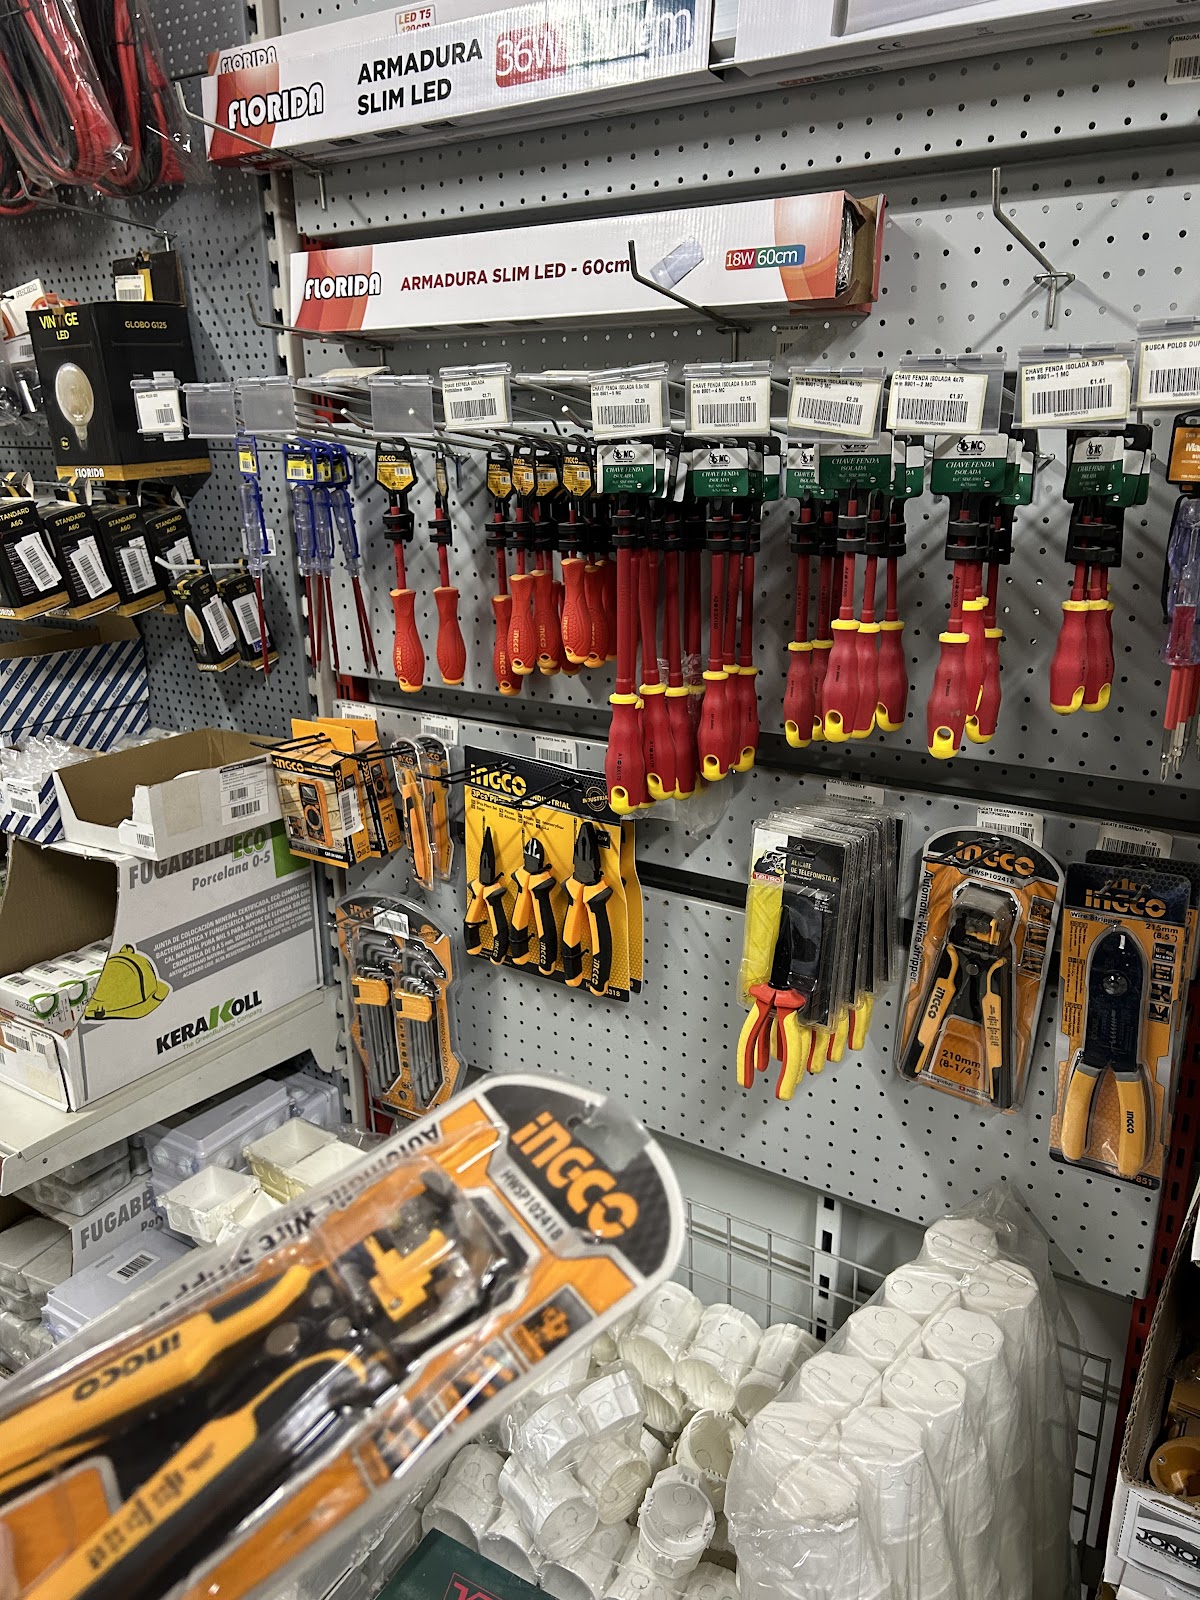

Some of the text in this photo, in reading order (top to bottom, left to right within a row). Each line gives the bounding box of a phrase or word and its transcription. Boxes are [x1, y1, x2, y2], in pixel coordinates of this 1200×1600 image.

[399, 8, 432, 25] LED T5
[357, 38, 482, 85] ARMADURA
[227, 82, 324, 130] FLORIDA
[357, 78, 452, 115] SLIM LED
[726, 248, 798, 267] 18W 60cm
[305, 271, 382, 300] FLORIDA
[401, 270, 488, 291] ARMADURA
[492, 264, 529, 283] SLIM
[534, 262, 566, 280] LED
[583, 258, 630, 275] 60cm
[56, 330, 70, 340] LED
[125, 320, 167, 329] GLOBO G125
[1144, 341, 1187, 351] BUSCA POLOS
[1066, 361, 1090, 370] ISOLADA
[75, 467, 105, 478] FLORIDA
[10, 519, 23, 528] A60
[55, 511, 86, 526] STANDARD
[68, 523, 80, 532] A60
[108, 513, 137, 528] STANDARD
[155, 514, 182, 529] STANDARD
[274, 758, 305, 773] INGCO
[470, 764, 527, 797] INGCO
[471, 789, 489, 801] 3Pcs
[232, 827, 267, 862] ECO
[192, 851, 271, 891] Porcelana 0-5
[791, 859, 812, 869] ALICATE
[955, 840, 1035, 876] INGCO
[798, 868, 833, 882] TELEFONISTA
[968, 867, 1015, 885] HWSP102418
[1070, 911, 1088, 920] Wire
[1085, 889, 1167, 918] INGCO
[152, 938, 171, 951] JUNTA
[179, 920, 214, 939] COLOCACIÓN
[214, 910, 237, 925] MINERAL
[155, 933, 203, 958] BACTERIOSTÁTICA
[208, 916, 244, 936] FUNGISTÁTICA
[244, 907, 267, 920] NATURAL
[266, 893, 299, 911] ESTABILIZADA
[300, 889, 310, 897] CON
[164, 955, 174, 963] CAL
[175, 944, 199, 958] NATURAL
[200, 937, 214, 947] PURA
[230, 925, 244, 935] PARA
[244, 916, 263, 929] JUNTAS
[271, 904, 291, 917] ELEVADA
[292, 896, 311, 908] SOLIDEZ
[909, 870, 934, 983] Automatic Wire Stripper
[1145, 923, 1179, 934] 215mm
[171, 950, 203, 968] CROMÁTICA
[254, 923, 266, 932] PARA
[591, 958, 600, 986] INGCO
[928, 986, 946, 1019] INGCO
[155, 990, 263, 1055] KERAKOLL
[182, 1008, 263, 1050] The GreenBuilding Company
[942, 1049, 981, 1069] 210mm
[1126, 1110, 1135, 1134] INGCO
[511, 1110, 639, 1239] INGCO
[72, 1330, 182, 1401] INGCO
